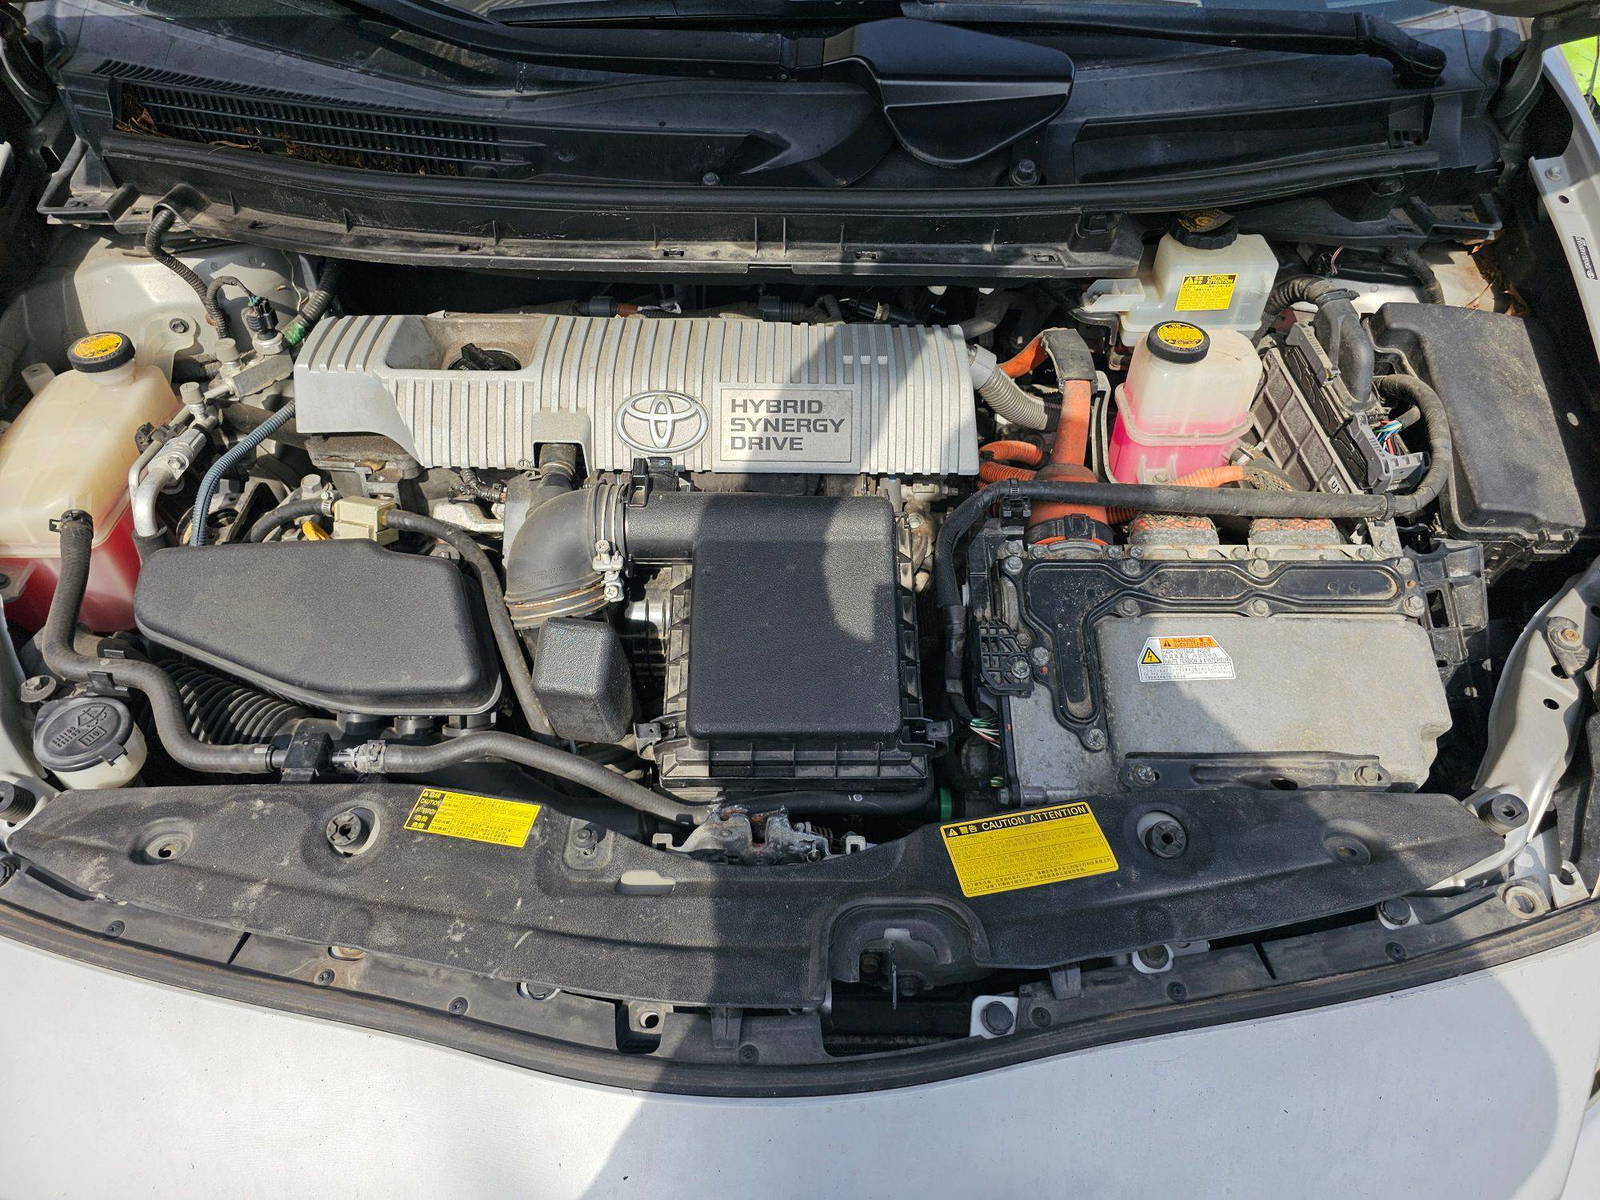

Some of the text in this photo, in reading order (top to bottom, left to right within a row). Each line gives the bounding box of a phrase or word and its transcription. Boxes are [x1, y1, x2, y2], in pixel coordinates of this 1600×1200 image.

[731, 399, 823, 414] HYBRID
[731, 417, 845, 433] SYNERGY
[731, 436, 804, 451] DRIVE
[981, 816, 1026, 831] CAUTION
[1030, 805, 1087, 822] ATTENTION
